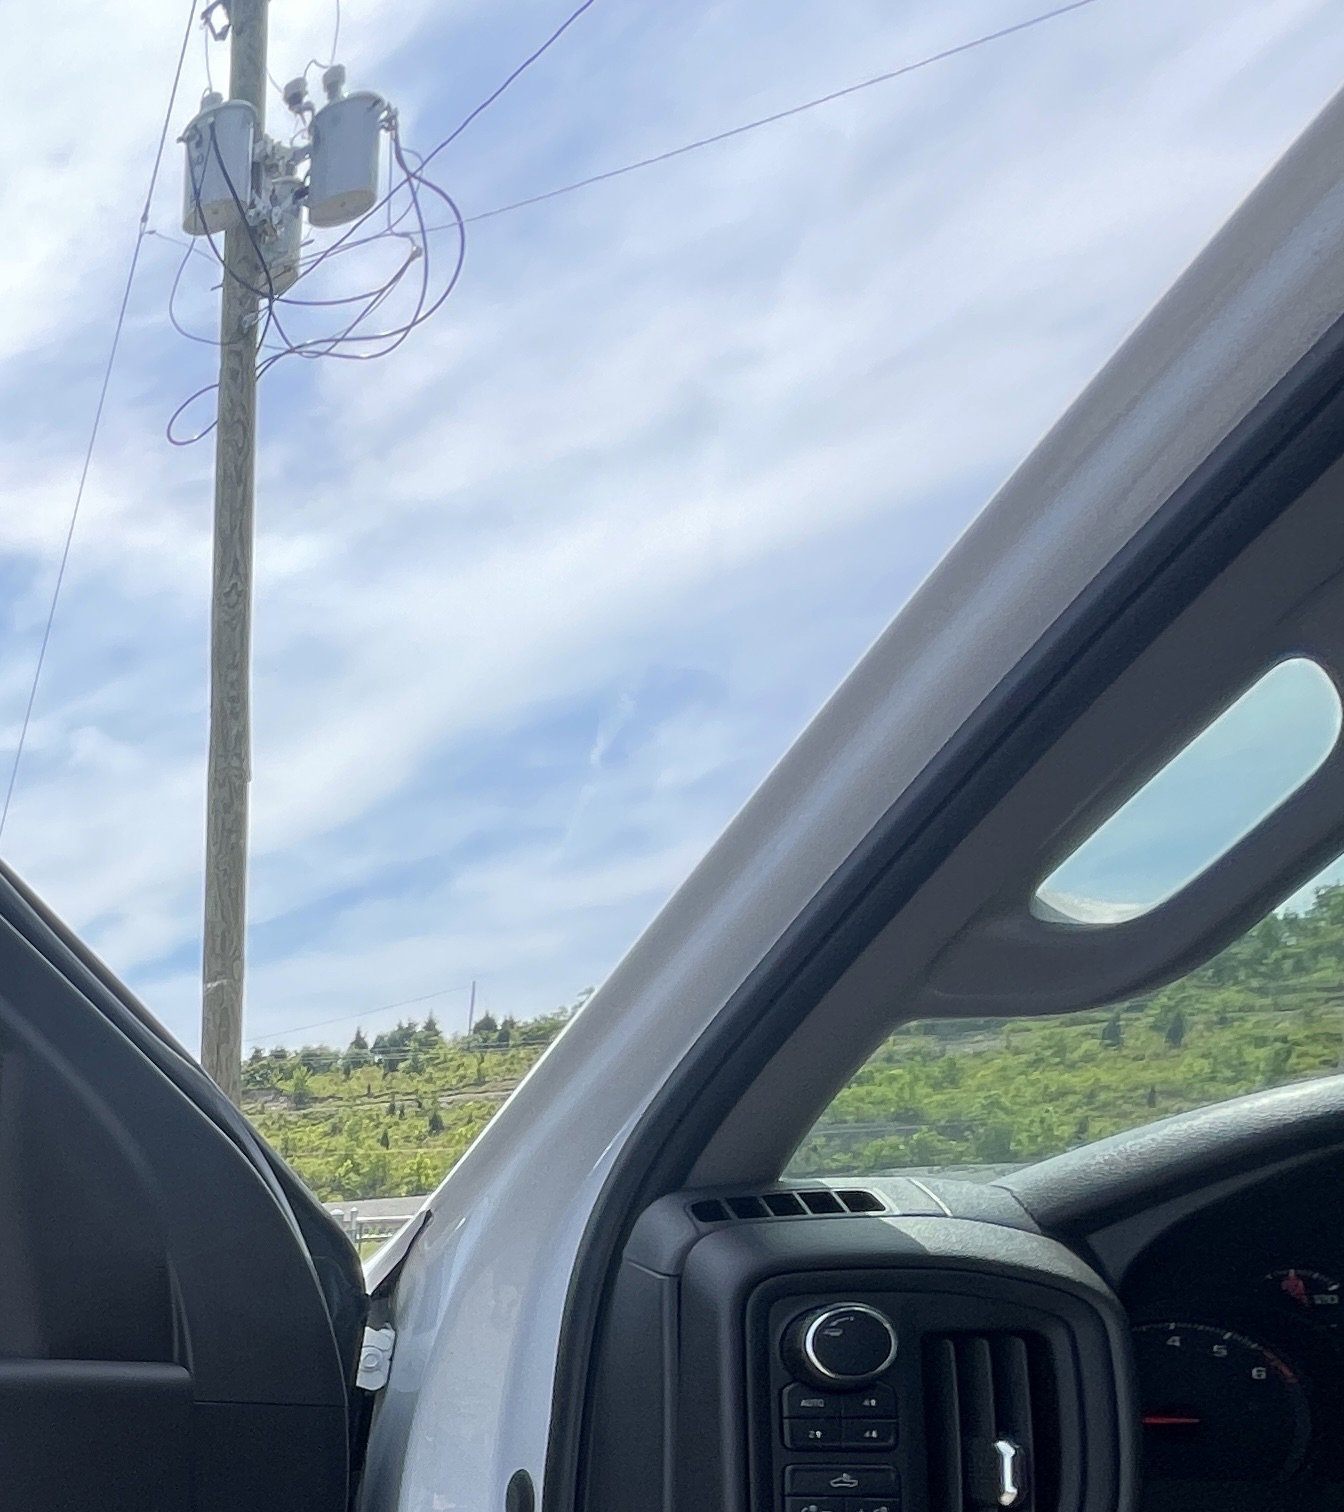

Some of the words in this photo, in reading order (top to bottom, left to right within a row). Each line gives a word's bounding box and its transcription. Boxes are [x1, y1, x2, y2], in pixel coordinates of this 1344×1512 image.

[1166, 1335, 1181, 1347] 4
[1213, 1344, 1228, 1357] 5
[1251, 1366, 1266, 1379] 6
[800, 1399, 824, 1407] AUTO
